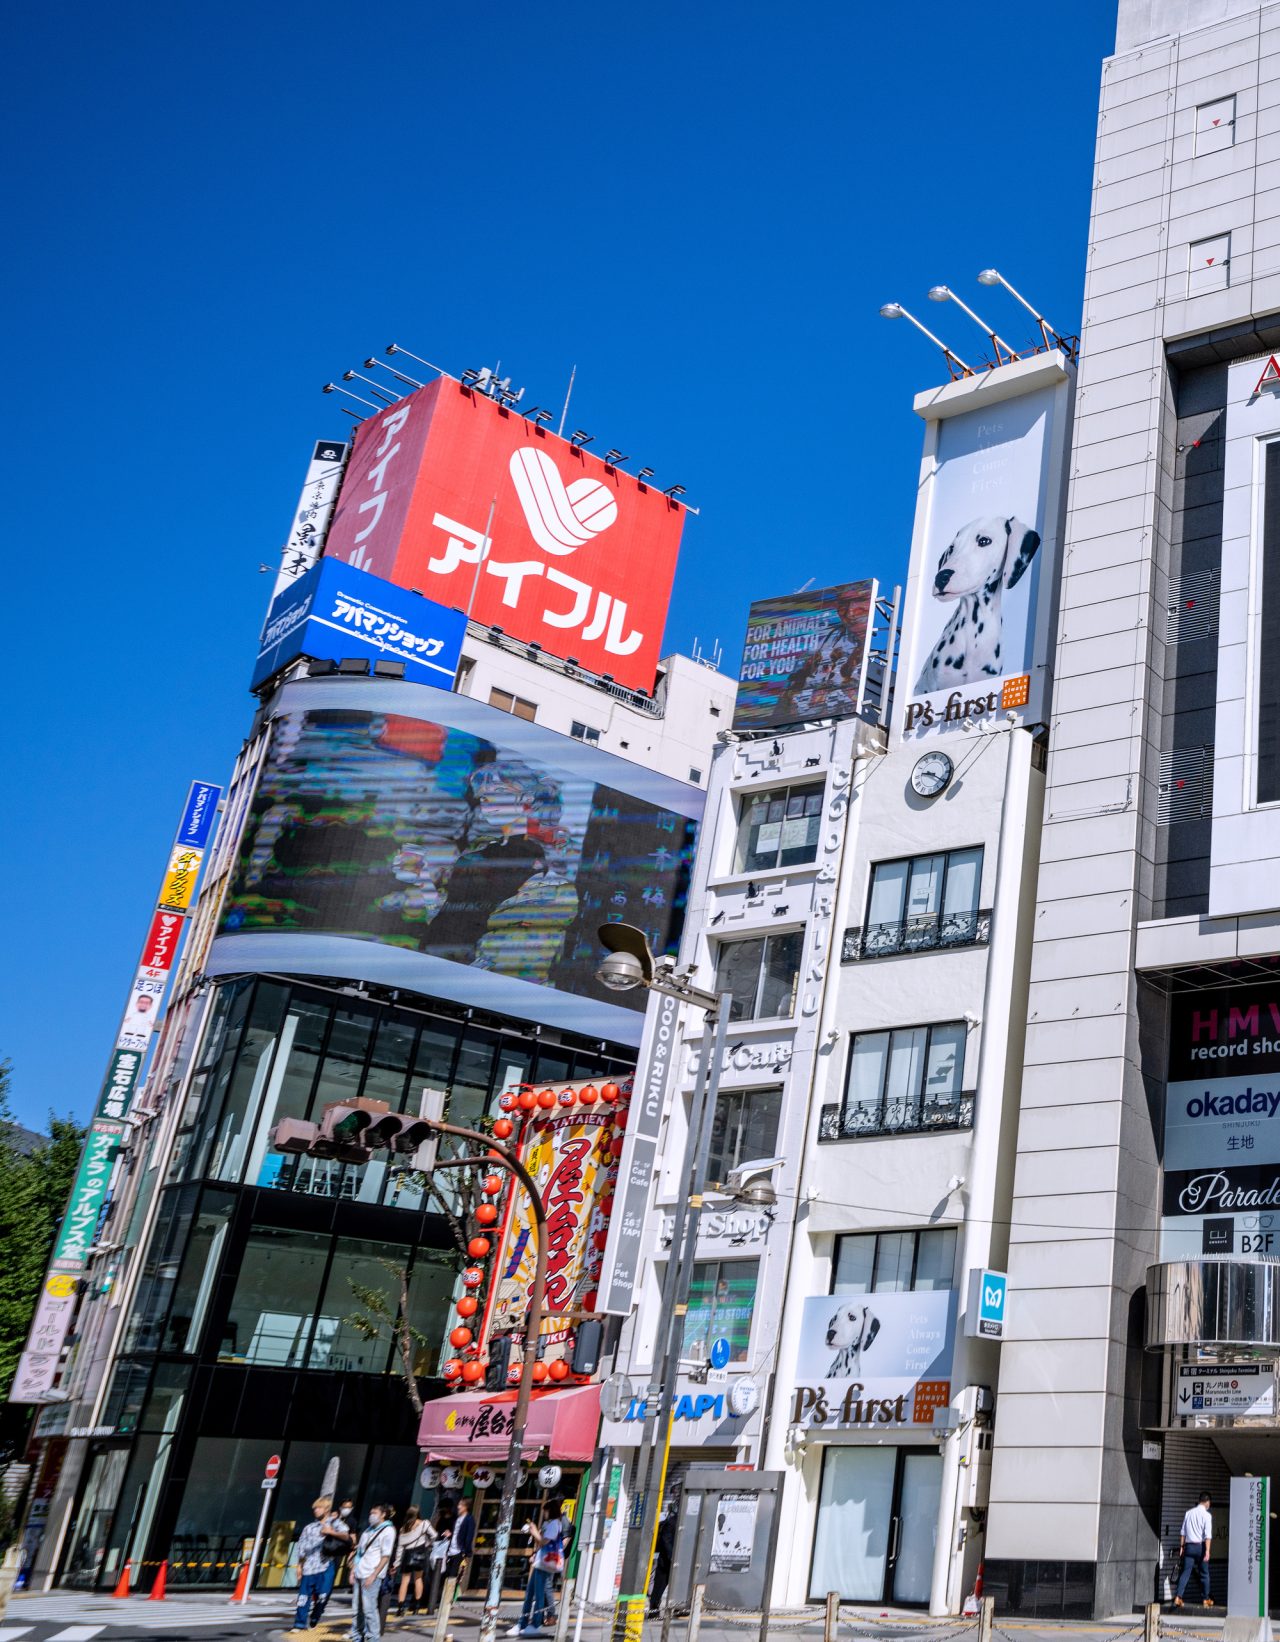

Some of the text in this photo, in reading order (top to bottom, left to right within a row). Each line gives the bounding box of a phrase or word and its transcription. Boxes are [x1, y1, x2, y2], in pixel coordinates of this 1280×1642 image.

[427, 512, 643, 656] アイフル
[332, 599, 445, 657] アパマンショップ
[746, 615, 829, 643] FOR ANIMALS
[743, 635, 820, 661] FOR HEALTH
[741, 656, 796, 680] FOR YOU
[903, 690, 998, 731] P's-first
[167, 851, 196, 905] ダーツグッズ
[150, 926, 173, 967] アイフル
[145, 968, 160, 978] 4F
[657, 995, 675, 1043] COO
[733, 1045, 792, 1069] Cafe
[1191, 1039, 1249, 1060] record
[103, 1053, 138, 1118] 宝石広場
[645, 1065, 667, 1118] RIKU
[552, 1114, 607, 1130] YATAIEN
[1222, 1120, 1261, 1129] SHINJUKU
[1226, 1134, 1255, 1151] 生地
[630, 1176, 649, 1188] Cafe
[632, 1166, 646, 1177] Cat
[707, 1215, 771, 1242] Shop
[1241, 1234, 1274, 1253] B2F
[612, 1278, 634, 1290] Shop
[613, 1268, 629, 1279] Pet
[917, 1384, 946, 1392] Pets
[917, 1393, 945, 1402] always
[672, 1394, 725, 1421] API
[791, 1383, 909, 1424] P's-first
[1254, 1481, 1264, 1562] Clean Shinjuku
